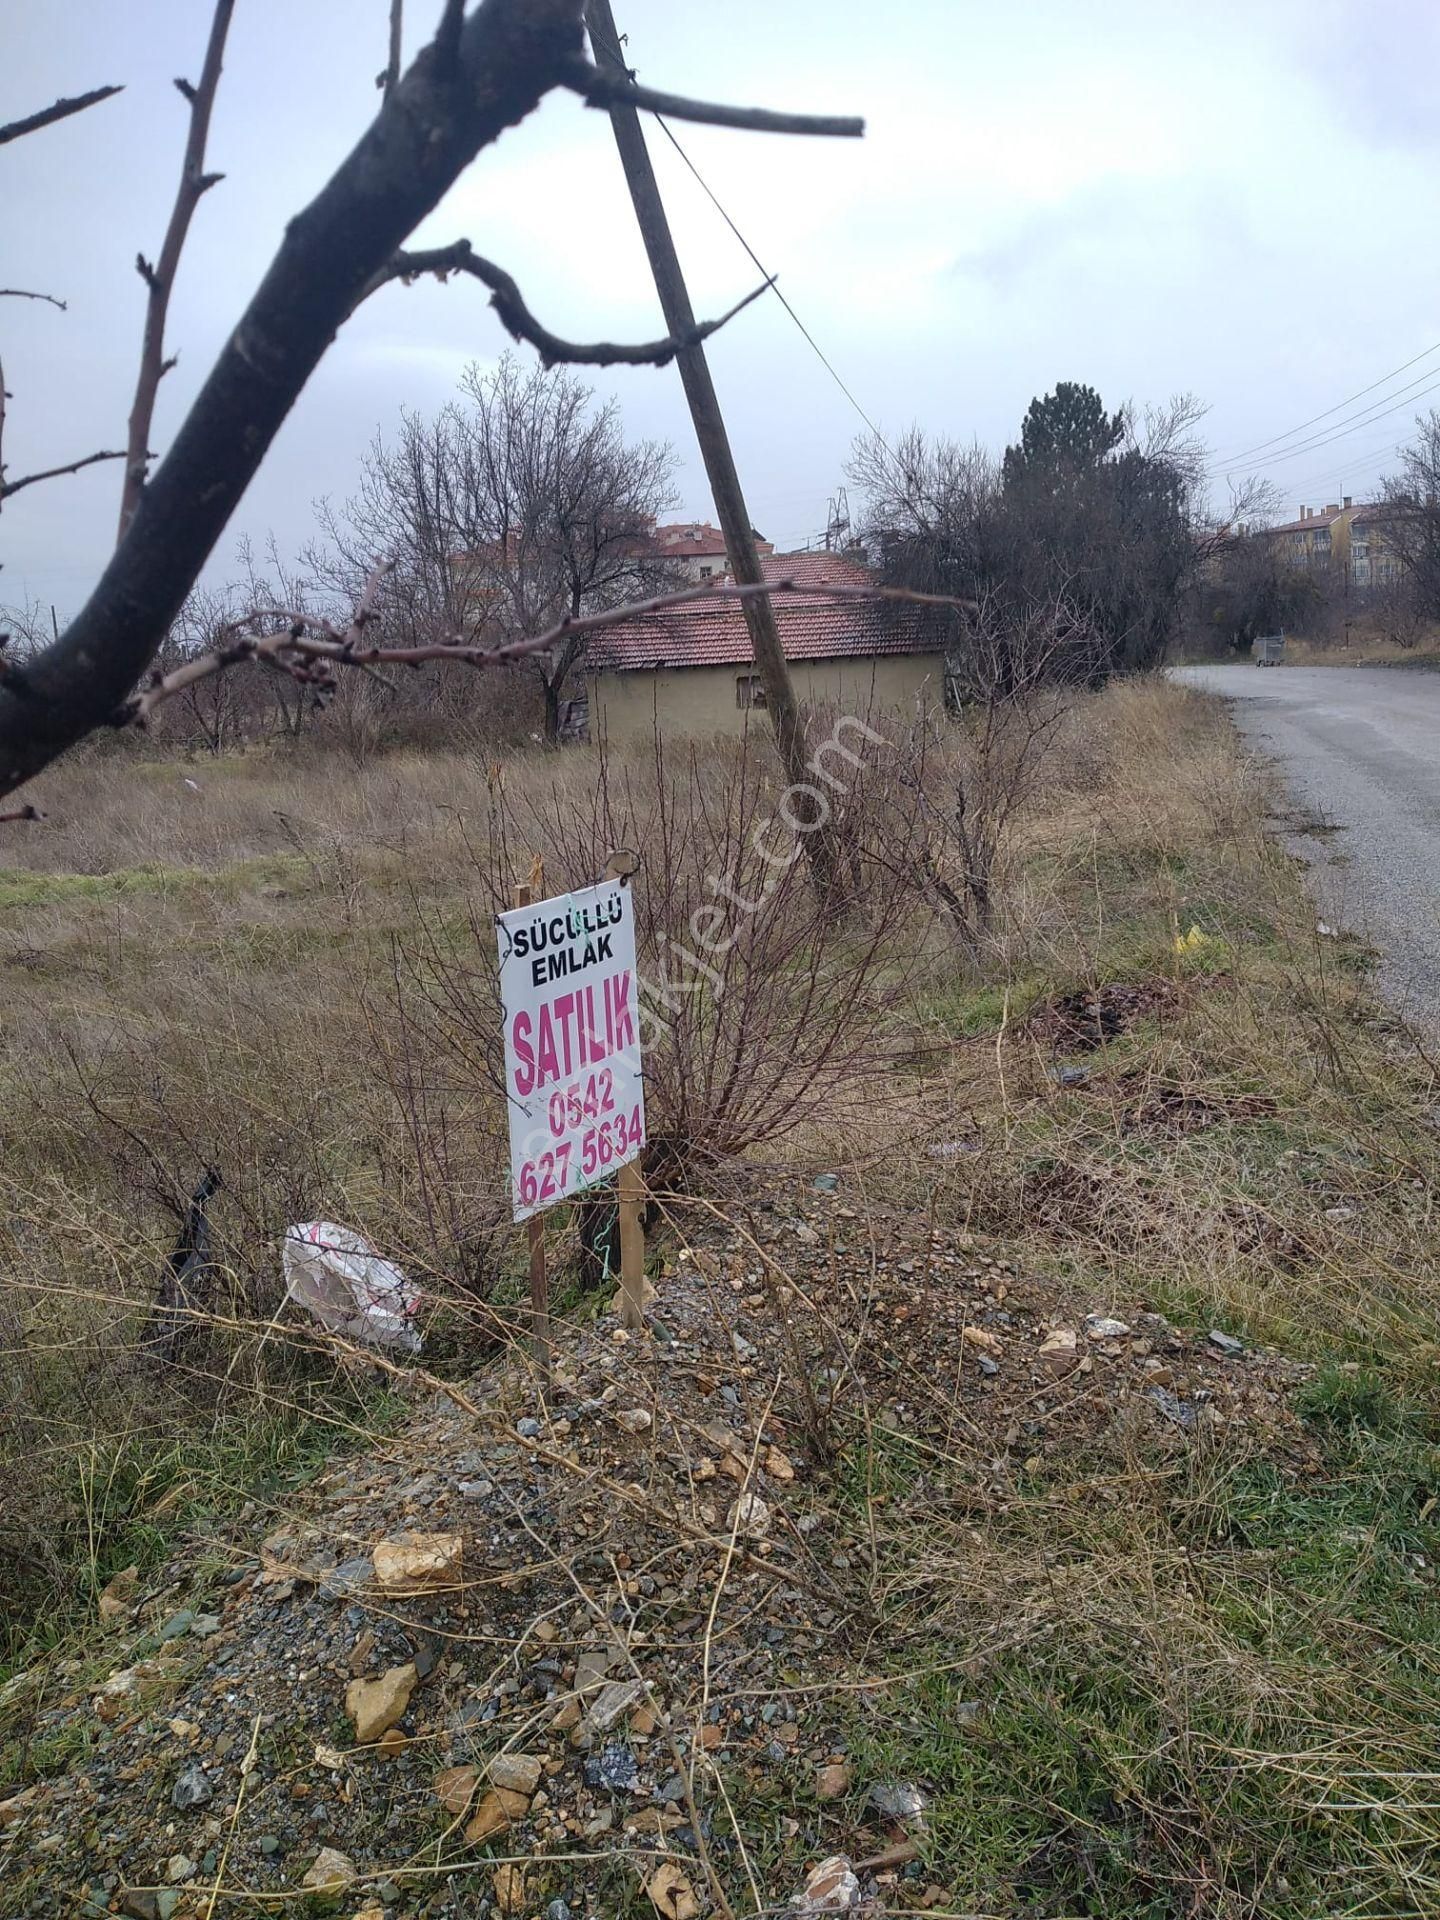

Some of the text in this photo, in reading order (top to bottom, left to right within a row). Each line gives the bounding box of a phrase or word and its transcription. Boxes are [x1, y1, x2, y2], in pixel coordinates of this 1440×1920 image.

[513, 892, 623, 958] SÜCÜLLÜ
[532, 932, 613, 987] EMLAK
[513, 969, 635, 1097] SATILIK
[549, 1067, 615, 1138] 0542
[520, 1103, 643, 1207] 627 5634
